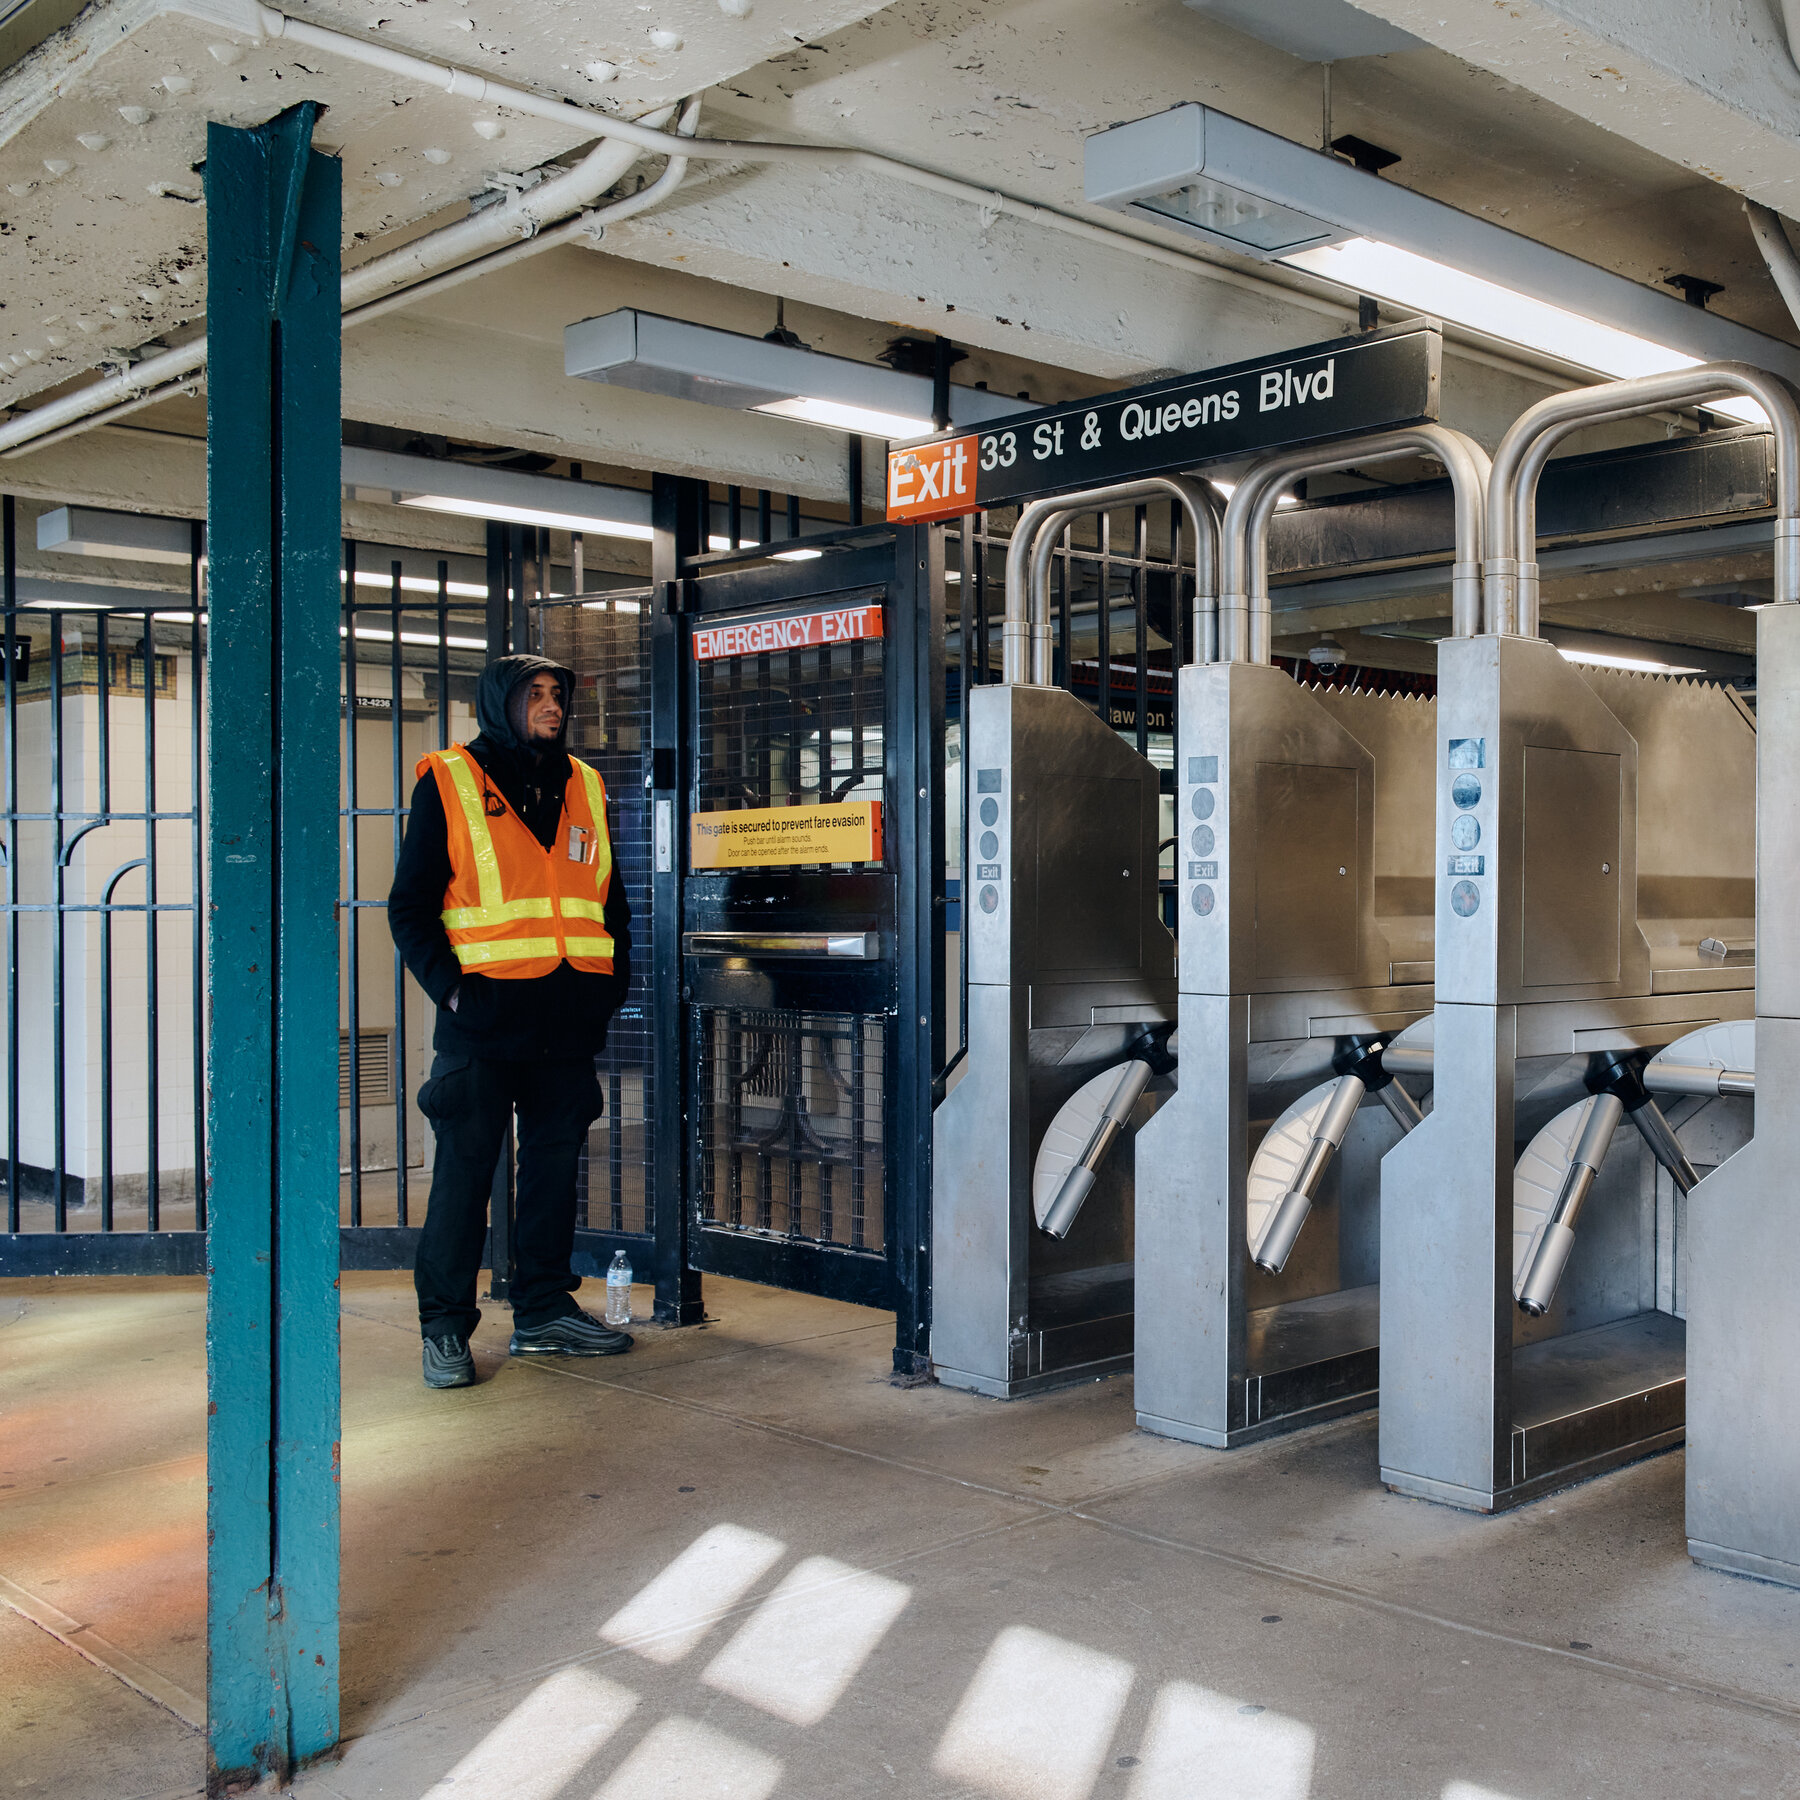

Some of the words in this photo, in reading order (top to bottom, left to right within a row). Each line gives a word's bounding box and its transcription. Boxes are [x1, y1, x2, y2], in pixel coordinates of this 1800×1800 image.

[889, 444, 968, 509] Exit
[980, 432, 1017, 472] 33
[1032, 421, 1064, 460] St
[1080, 411, 1102, 450] &
[1119, 389, 1240, 440] Queens
[1259, 359, 1335, 413] Blvd
[697, 617, 813, 659] EMERGENCY
[821, 610, 867, 642] EXIT
[1109, 706, 1165, 727] awon
[696, 822, 712, 835] This
[713, 822, 730, 837] gate
[731, 821, 738, 834] is
[739, 819, 771, 834] secured
[772, 819, 780, 831] to
[781, 816, 813, 833] prevent
[814, 816, 831, 829] fare
[832, 813, 865, 828] evasion
[743, 836, 755, 846] Push
[756, 836, 765, 845] bar
[766, 836, 776, 844] until
[777, 835, 791, 844] alarm
[728, 848, 740, 858] Door
[741, 849, 750, 857] can
[751, 848, 757, 857] be
[758, 848, 777, 857] opened
[778, 847, 790, 855] after
[791, 846, 799, 855] the
[800, 846, 814, 854] alarm
[981, 866, 998, 878] Exit
[1194, 864, 1215, 877] Exit
[1454, 859, 1480, 873] Exit
